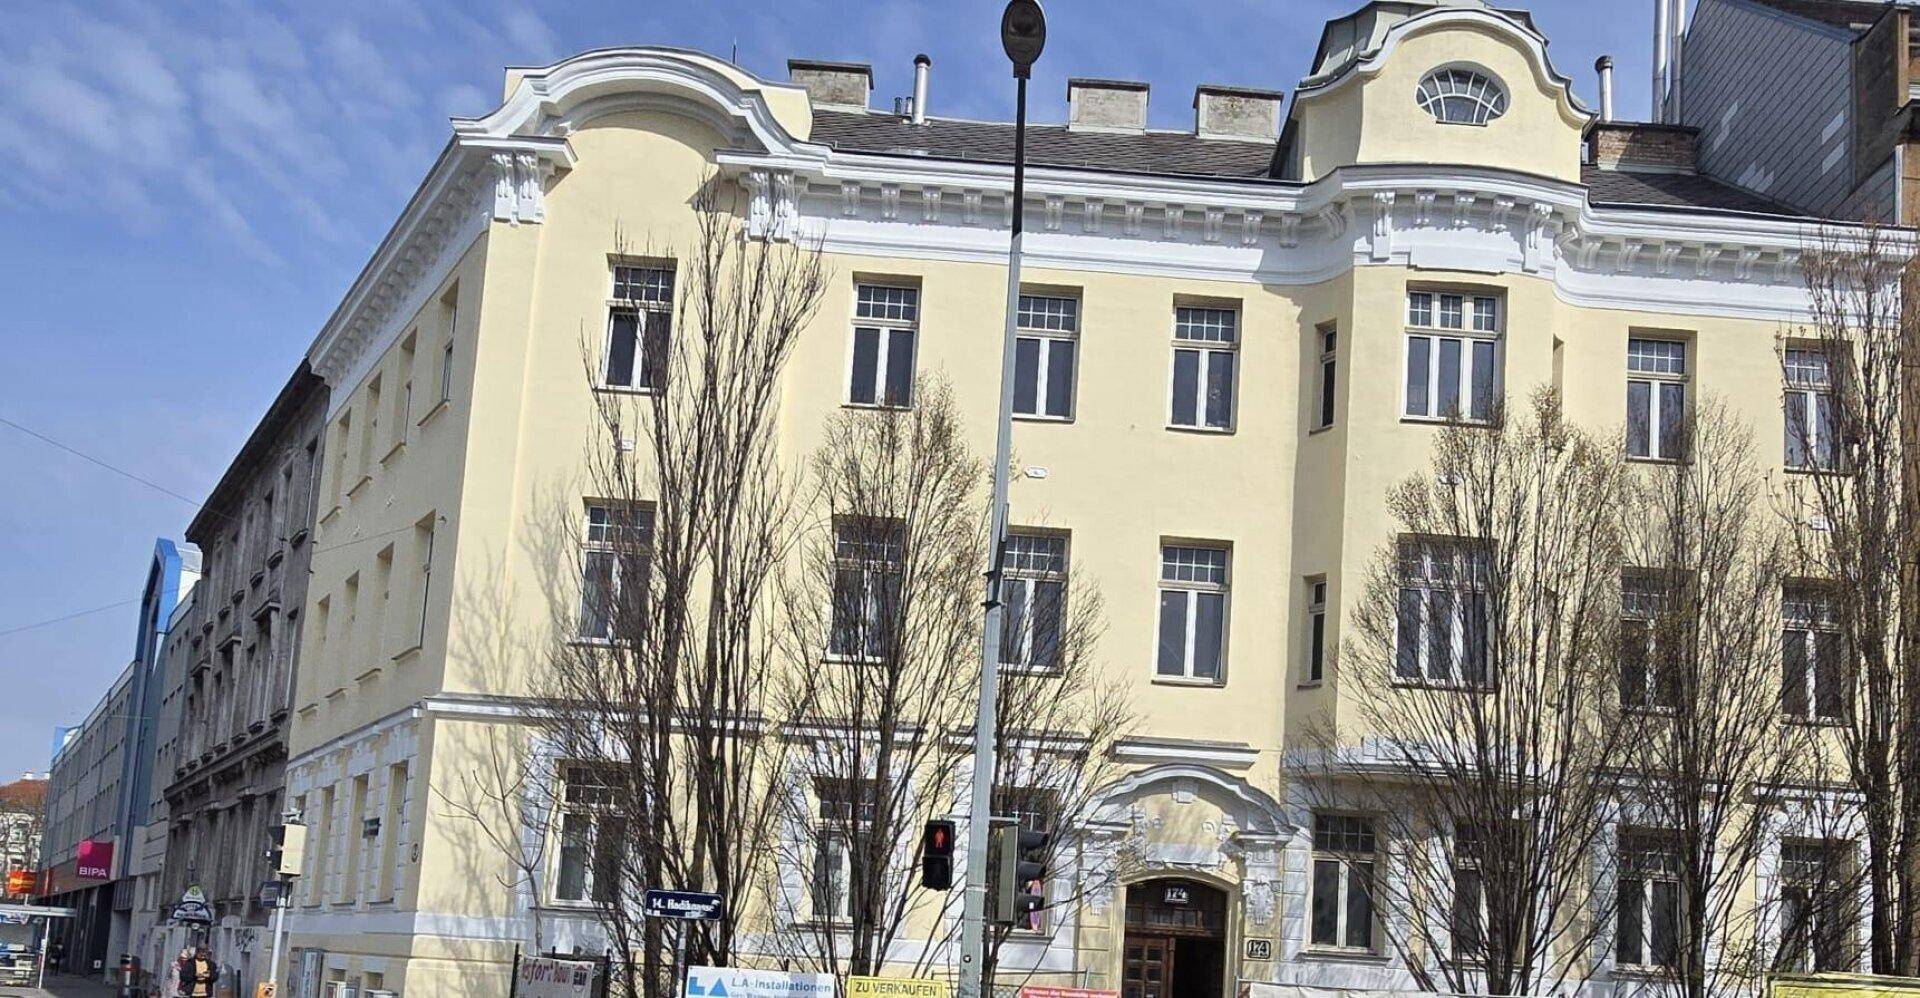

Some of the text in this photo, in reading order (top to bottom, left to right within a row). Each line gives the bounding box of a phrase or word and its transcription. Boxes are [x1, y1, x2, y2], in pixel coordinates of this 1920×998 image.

[78, 866, 107, 878] BIPA
[1249, 939, 1268, 952] 174
[855, 982, 937, 996] ZU VERKAUFEN
